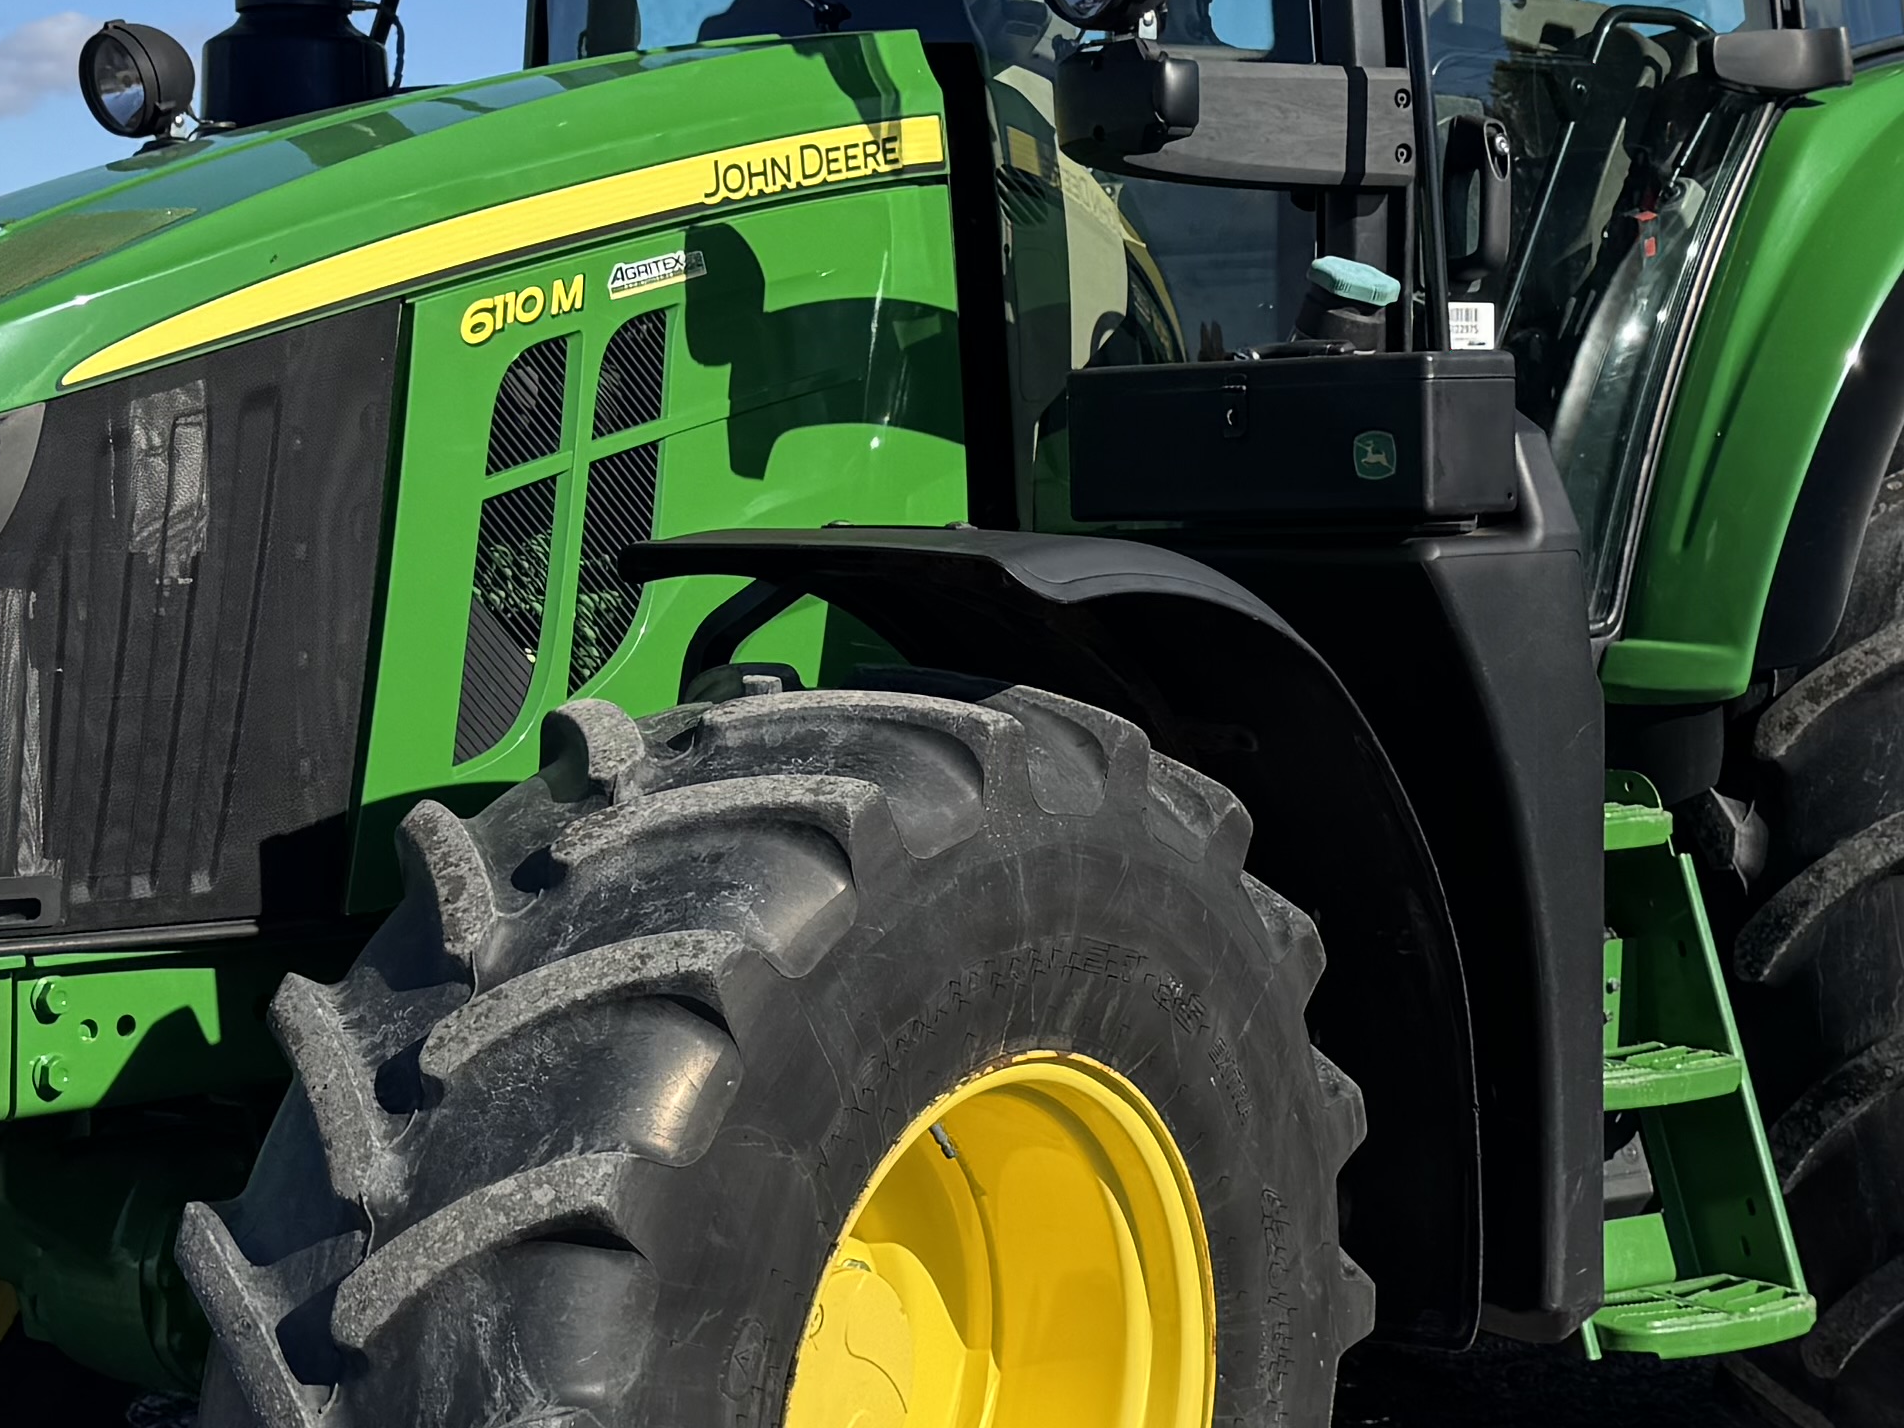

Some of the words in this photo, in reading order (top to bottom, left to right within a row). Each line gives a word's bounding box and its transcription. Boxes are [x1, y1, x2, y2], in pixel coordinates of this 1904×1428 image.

[704, 154, 791, 200] JOHN
[800, 135, 900, 180] DEERE
[610, 255, 685, 286] AGRITEX
[460, 286, 545, 346] 6110
[550, 274, 584, 316] M
